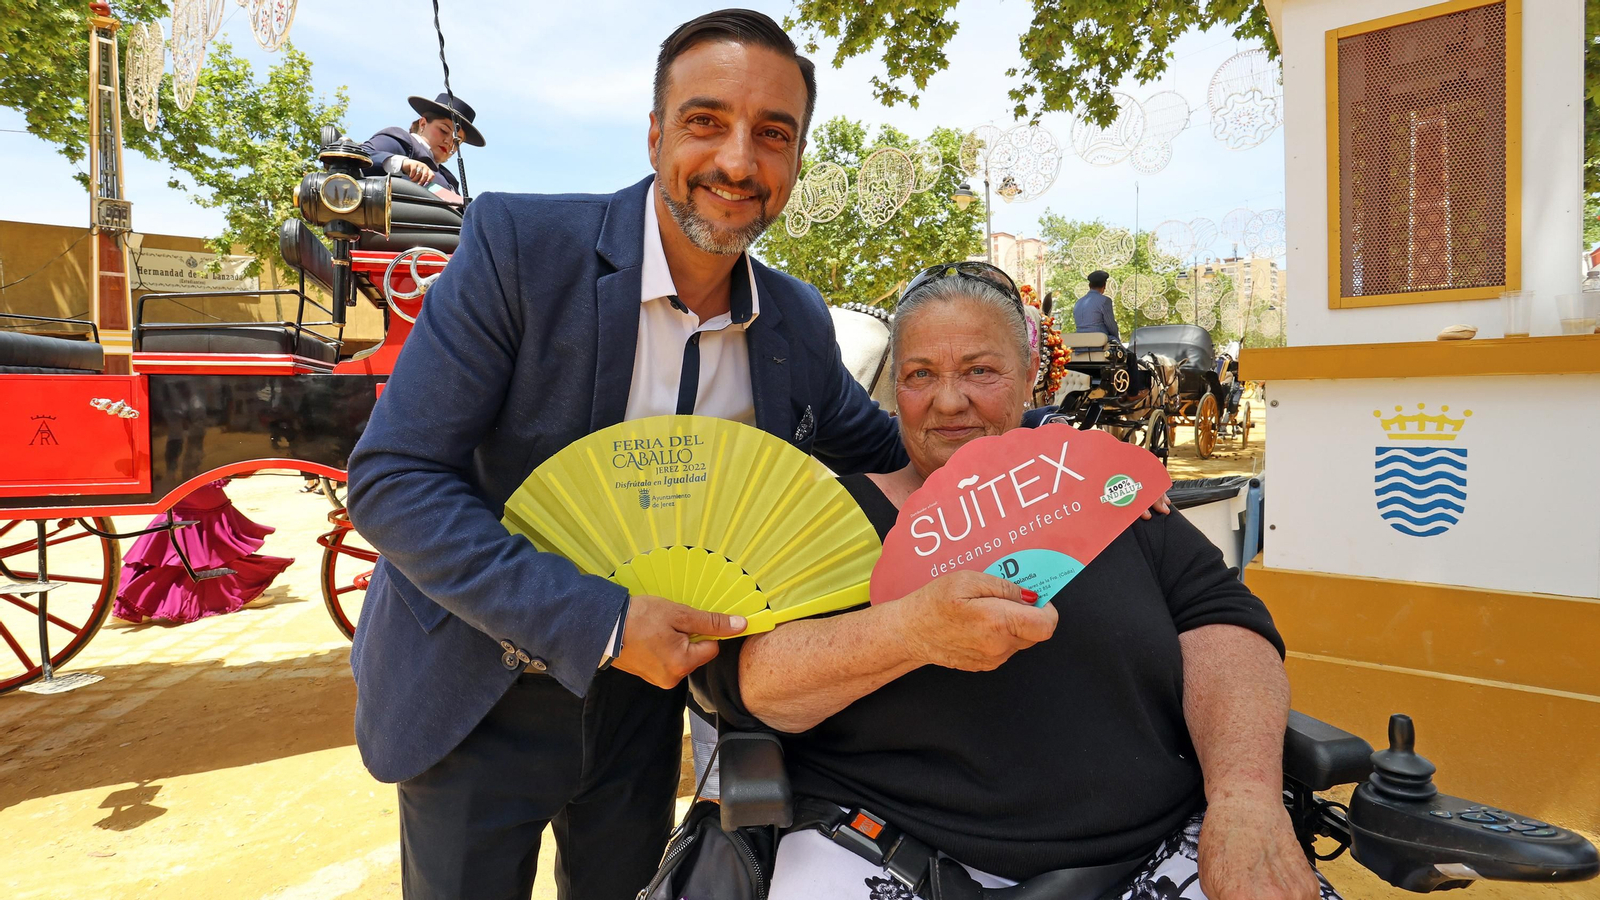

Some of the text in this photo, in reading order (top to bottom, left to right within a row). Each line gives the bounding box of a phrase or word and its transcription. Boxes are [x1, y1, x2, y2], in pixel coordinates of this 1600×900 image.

[138, 266, 184, 278] Hermandad
[188, 270, 197, 278] de
[613, 435, 704, 451] FERIA DEL
[612, 448, 693, 471] CABALLO
[656, 463, 706, 475] JEREZ 2022
[615, 479, 652, 490] Disfrútalo
[664, 472, 707, 487] Igualdad
[1108, 479, 1131, 494] 100%
[652, 493, 691, 503] Ayuntamiento
[1101, 482, 1142, 503] ANDALUZ
[661, 501, 675, 509] Jerez
[930, 501, 1082, 578] descanso perfecto
[1013, 573, 1037, 585] solandia
